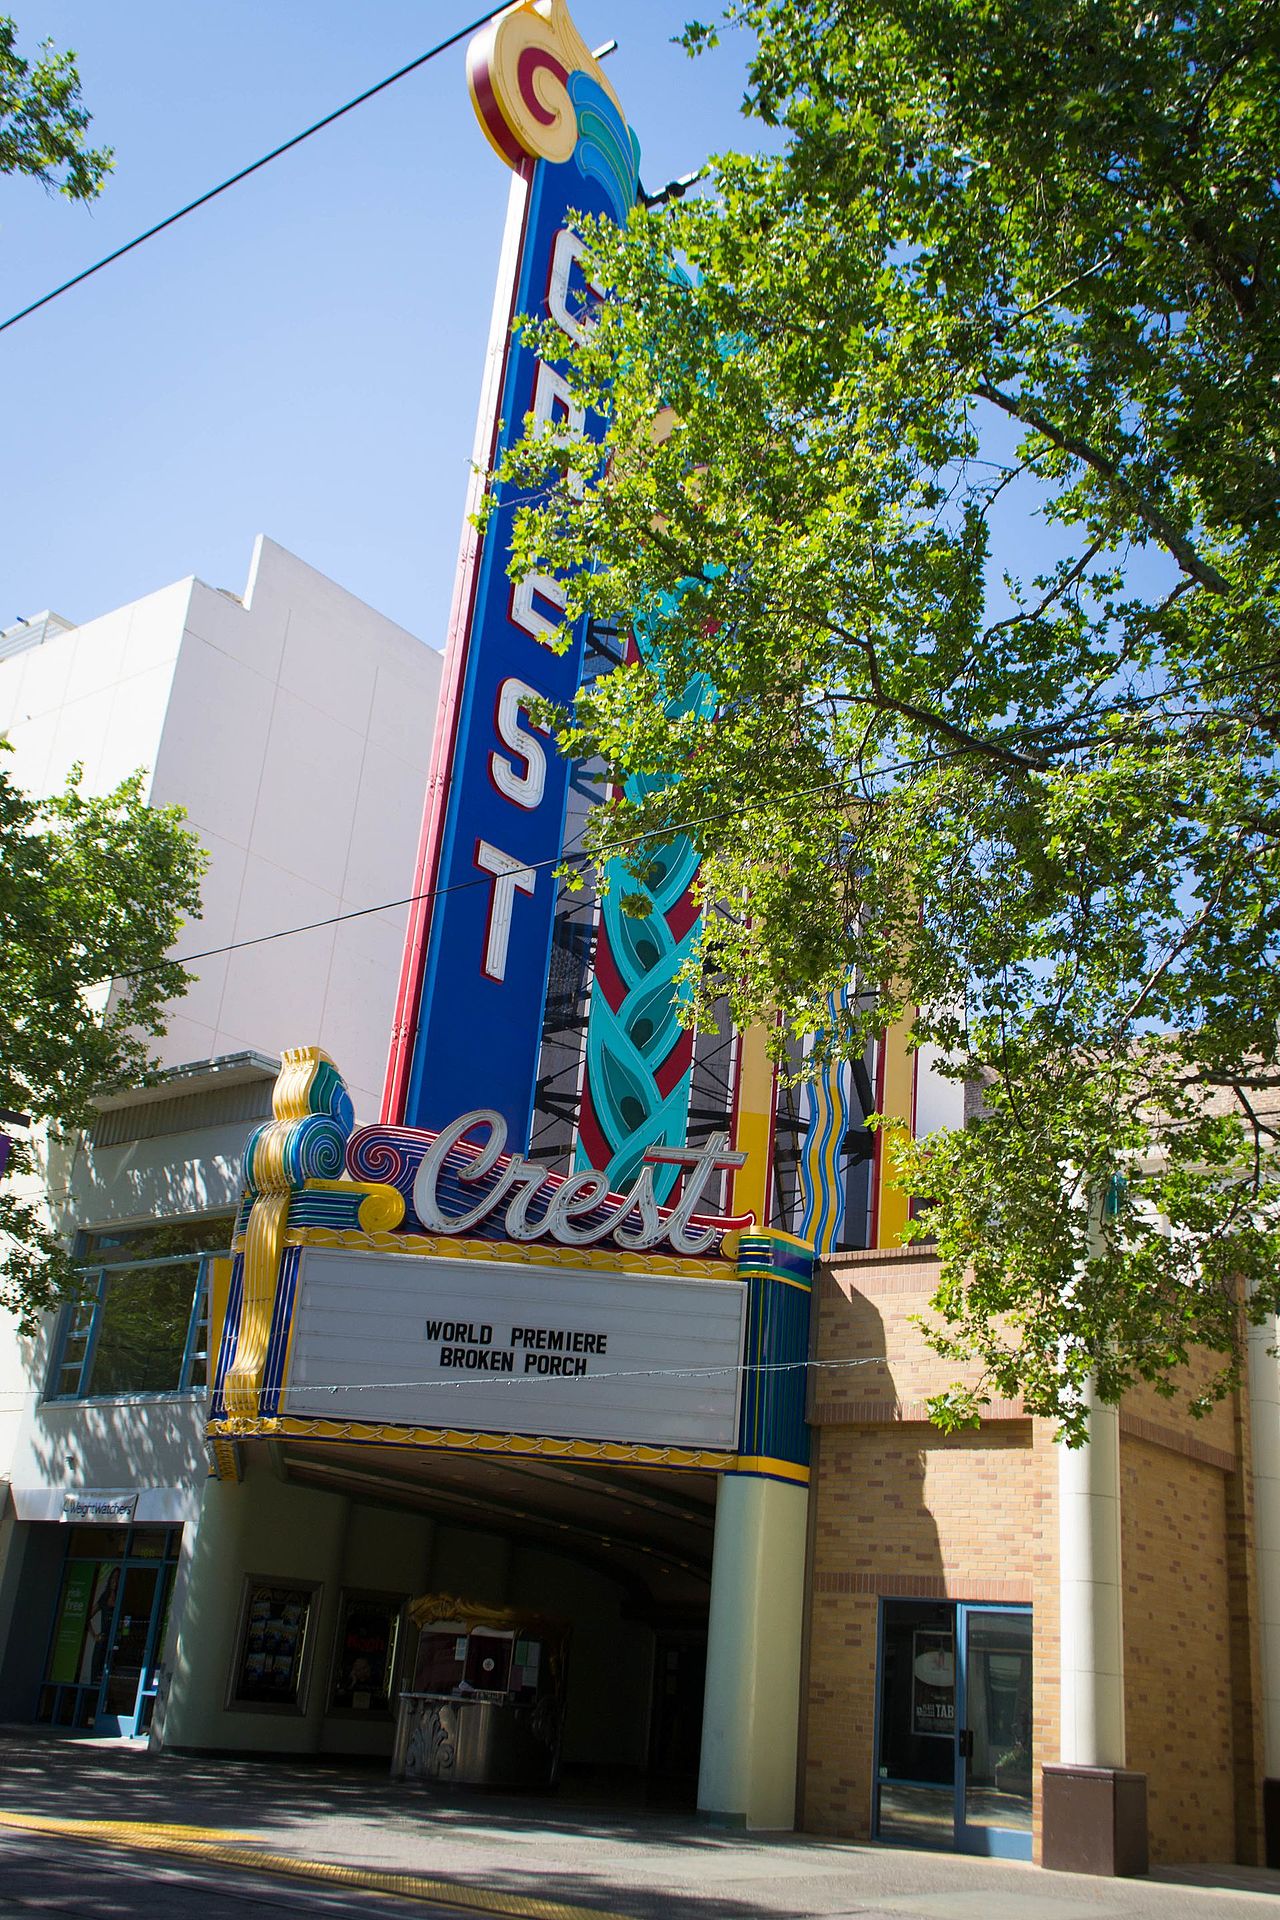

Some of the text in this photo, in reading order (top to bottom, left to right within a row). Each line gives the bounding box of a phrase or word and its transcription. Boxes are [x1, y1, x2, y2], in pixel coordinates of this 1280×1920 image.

[414, 1109, 748, 1255] Crest
[426, 1320, 607, 1354] WORLD PREMIERE
[440, 1347, 587, 1376] BROKEN PORCH
